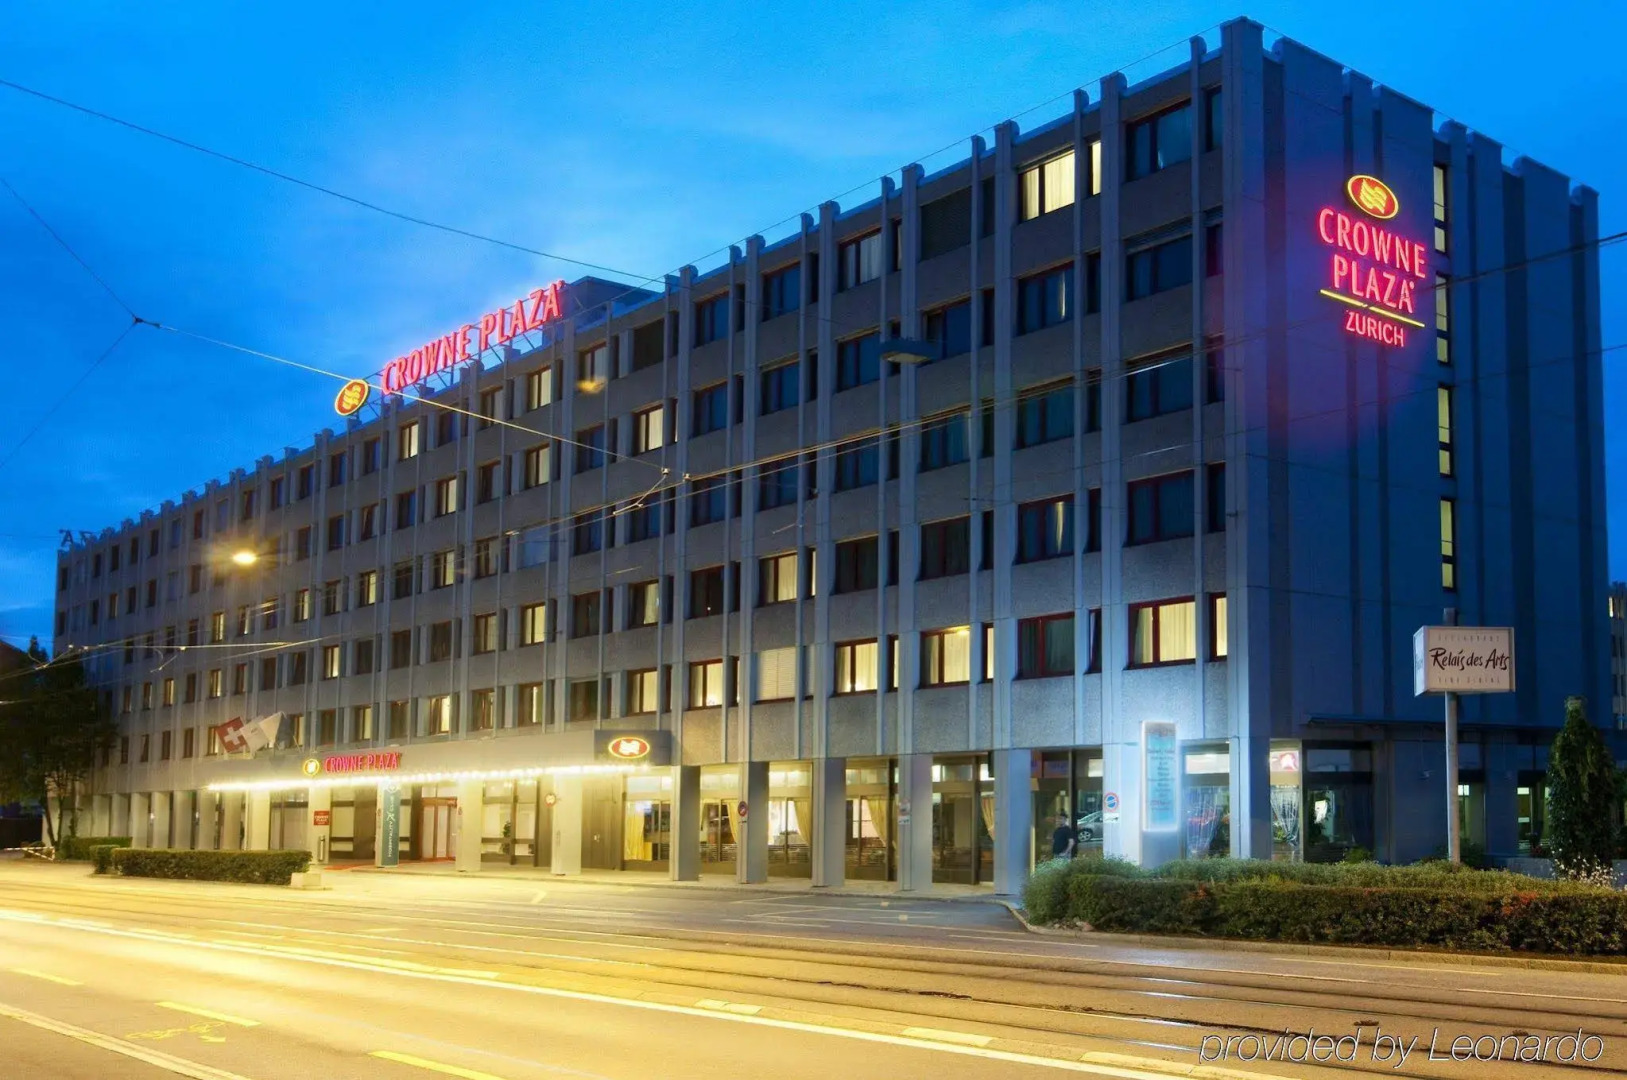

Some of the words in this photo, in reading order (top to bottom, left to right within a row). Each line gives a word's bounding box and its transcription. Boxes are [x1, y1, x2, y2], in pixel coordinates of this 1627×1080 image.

[1319, 208, 1426, 279] CROWNE
[1333, 253, 1414, 314] PLAZA
[381, 324, 472, 395] CROWNE
[480, 282, 563, 351] PLAZA
[1429, 647, 1465, 671] Relais
[1466, 651, 1483, 667] des
[1485, 648, 1511, 671] Arts
[324, 755, 363, 774] CROWNE
[367, 752, 398, 770] PLAZA
